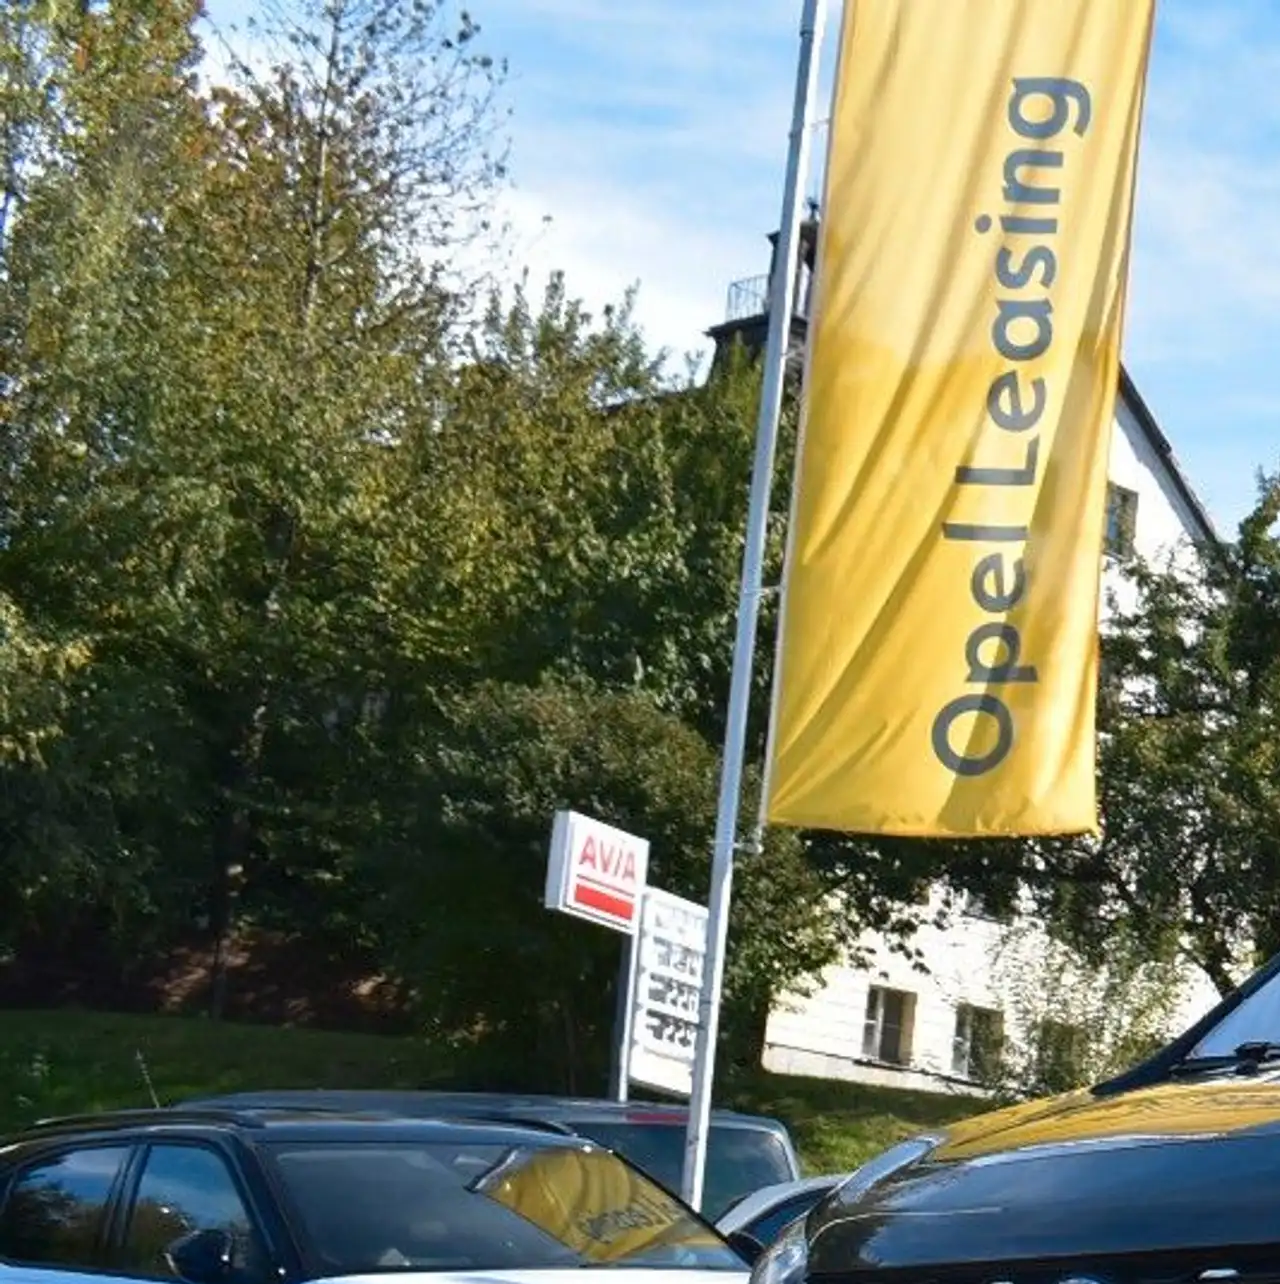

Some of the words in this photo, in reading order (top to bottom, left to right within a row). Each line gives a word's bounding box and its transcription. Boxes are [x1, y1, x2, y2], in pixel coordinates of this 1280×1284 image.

[956, 74, 1092, 489] Leasing
[930, 521, 1040, 778] Opel
[578, 835, 637, 882] AVIA
